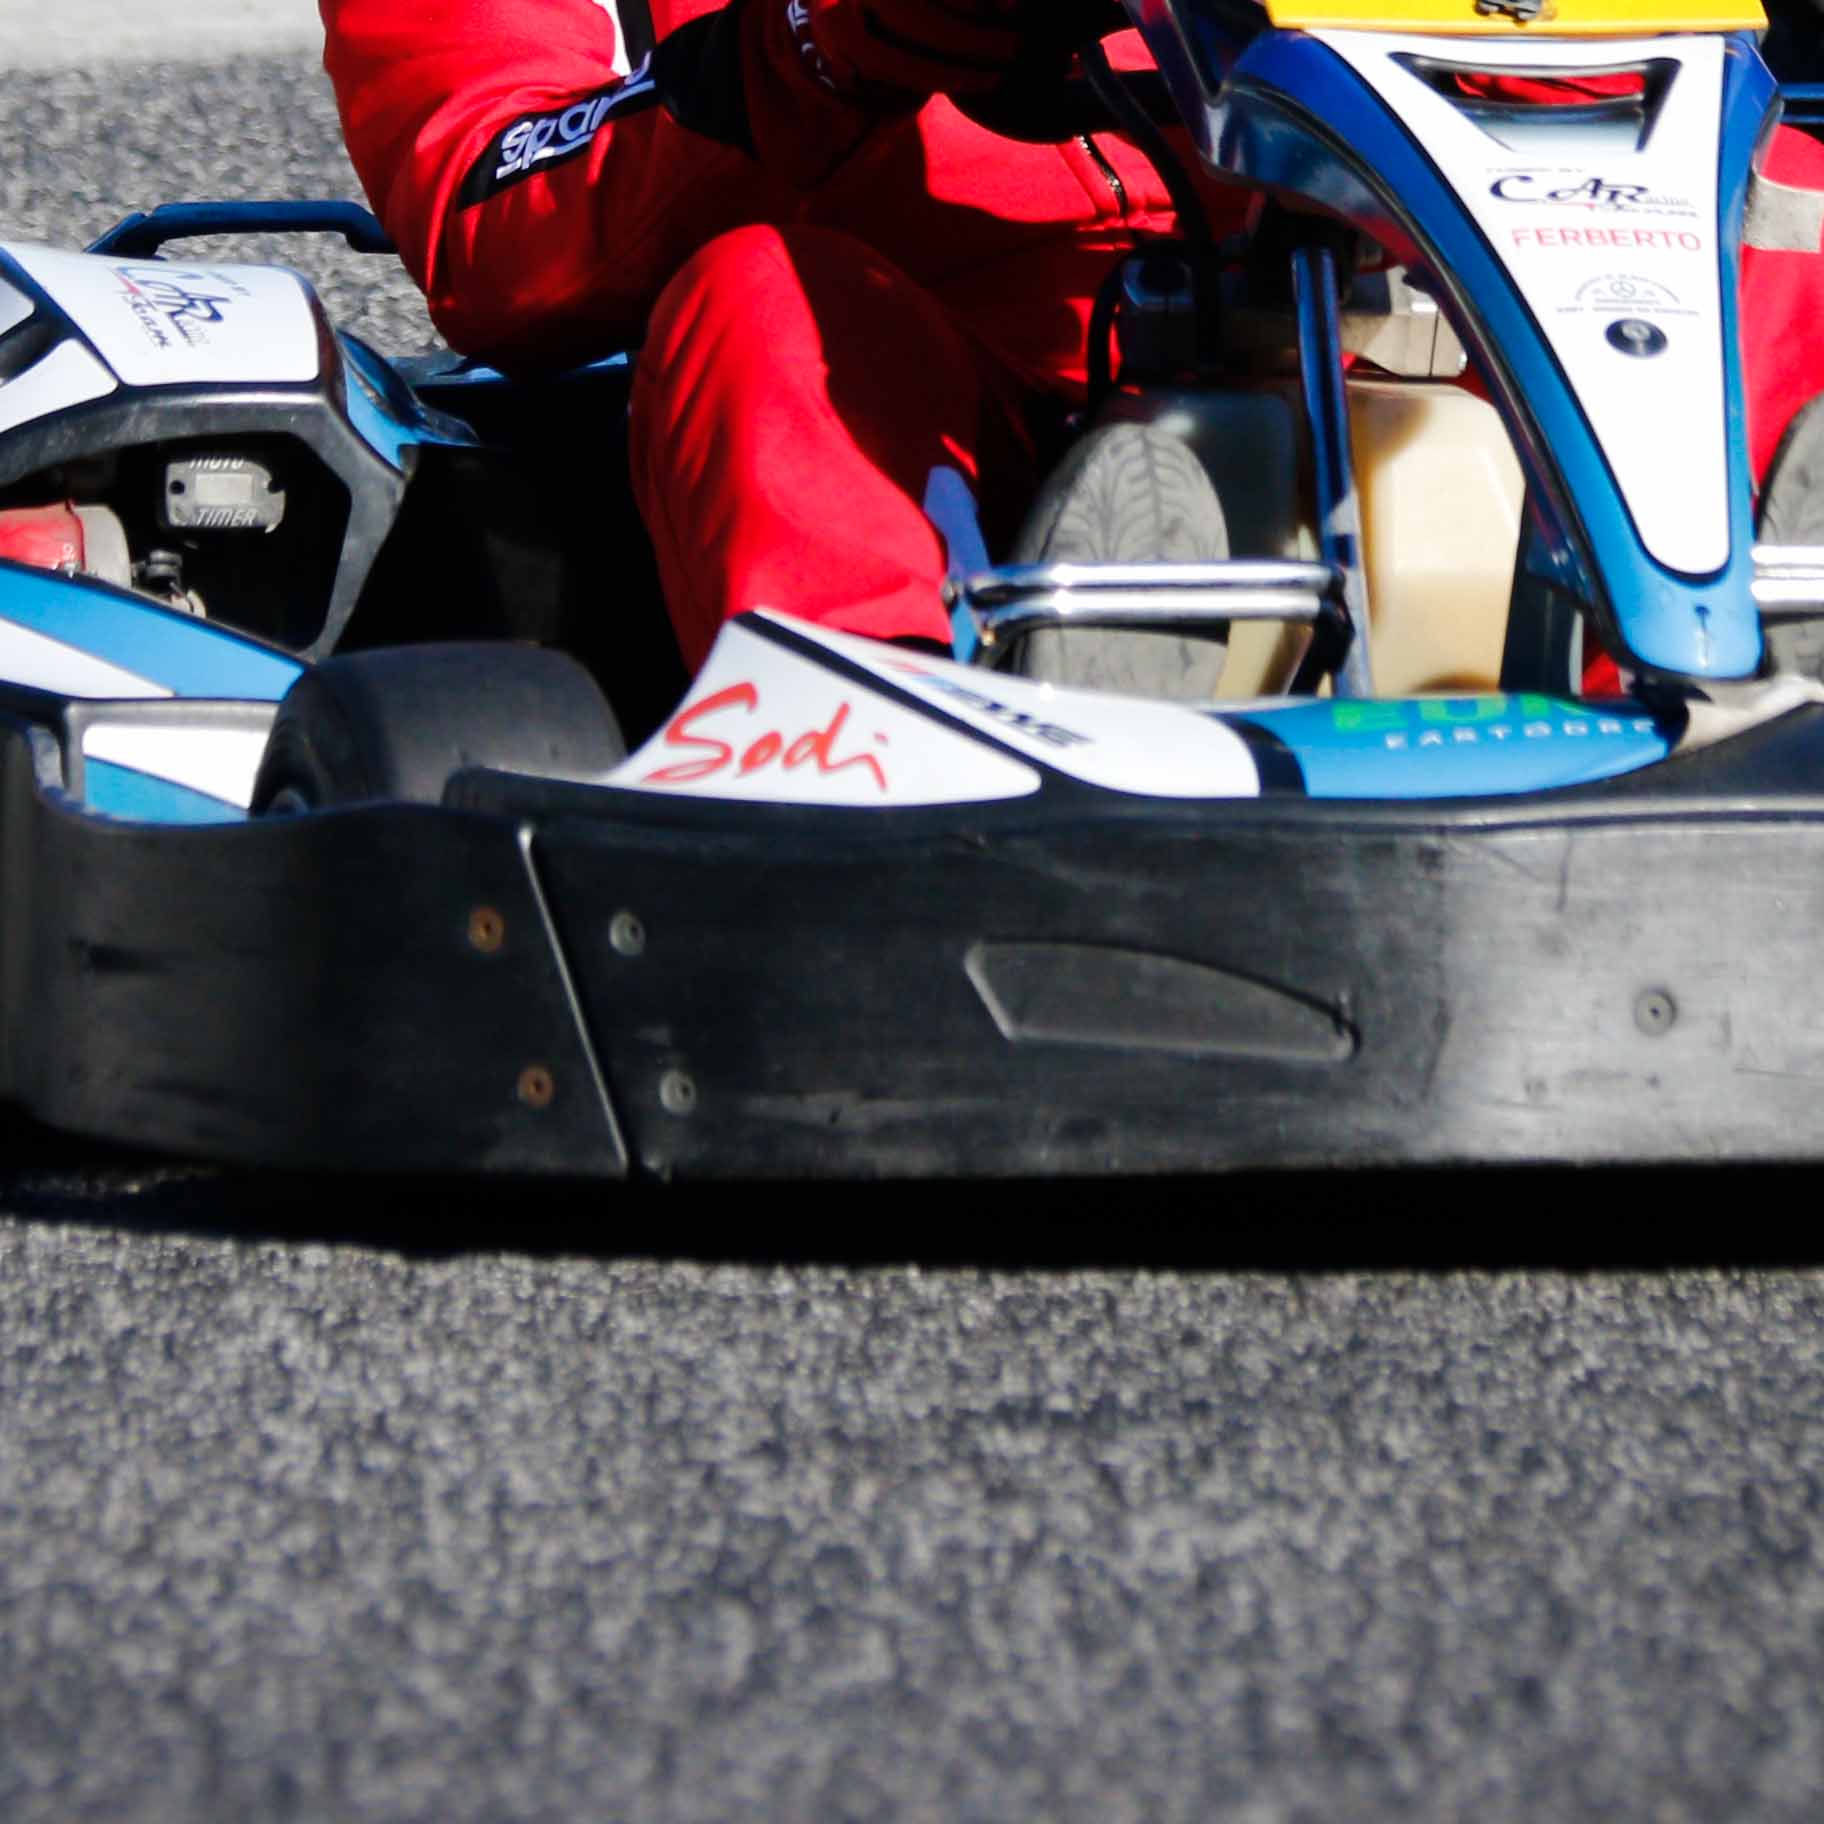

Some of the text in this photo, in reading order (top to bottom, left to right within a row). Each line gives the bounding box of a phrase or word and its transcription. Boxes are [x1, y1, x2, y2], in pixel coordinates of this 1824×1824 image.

[1511, 226, 1702, 253] FERBERTO
[196, 507, 259, 526] TIMER
[641, 681, 891, 793] Sodi
